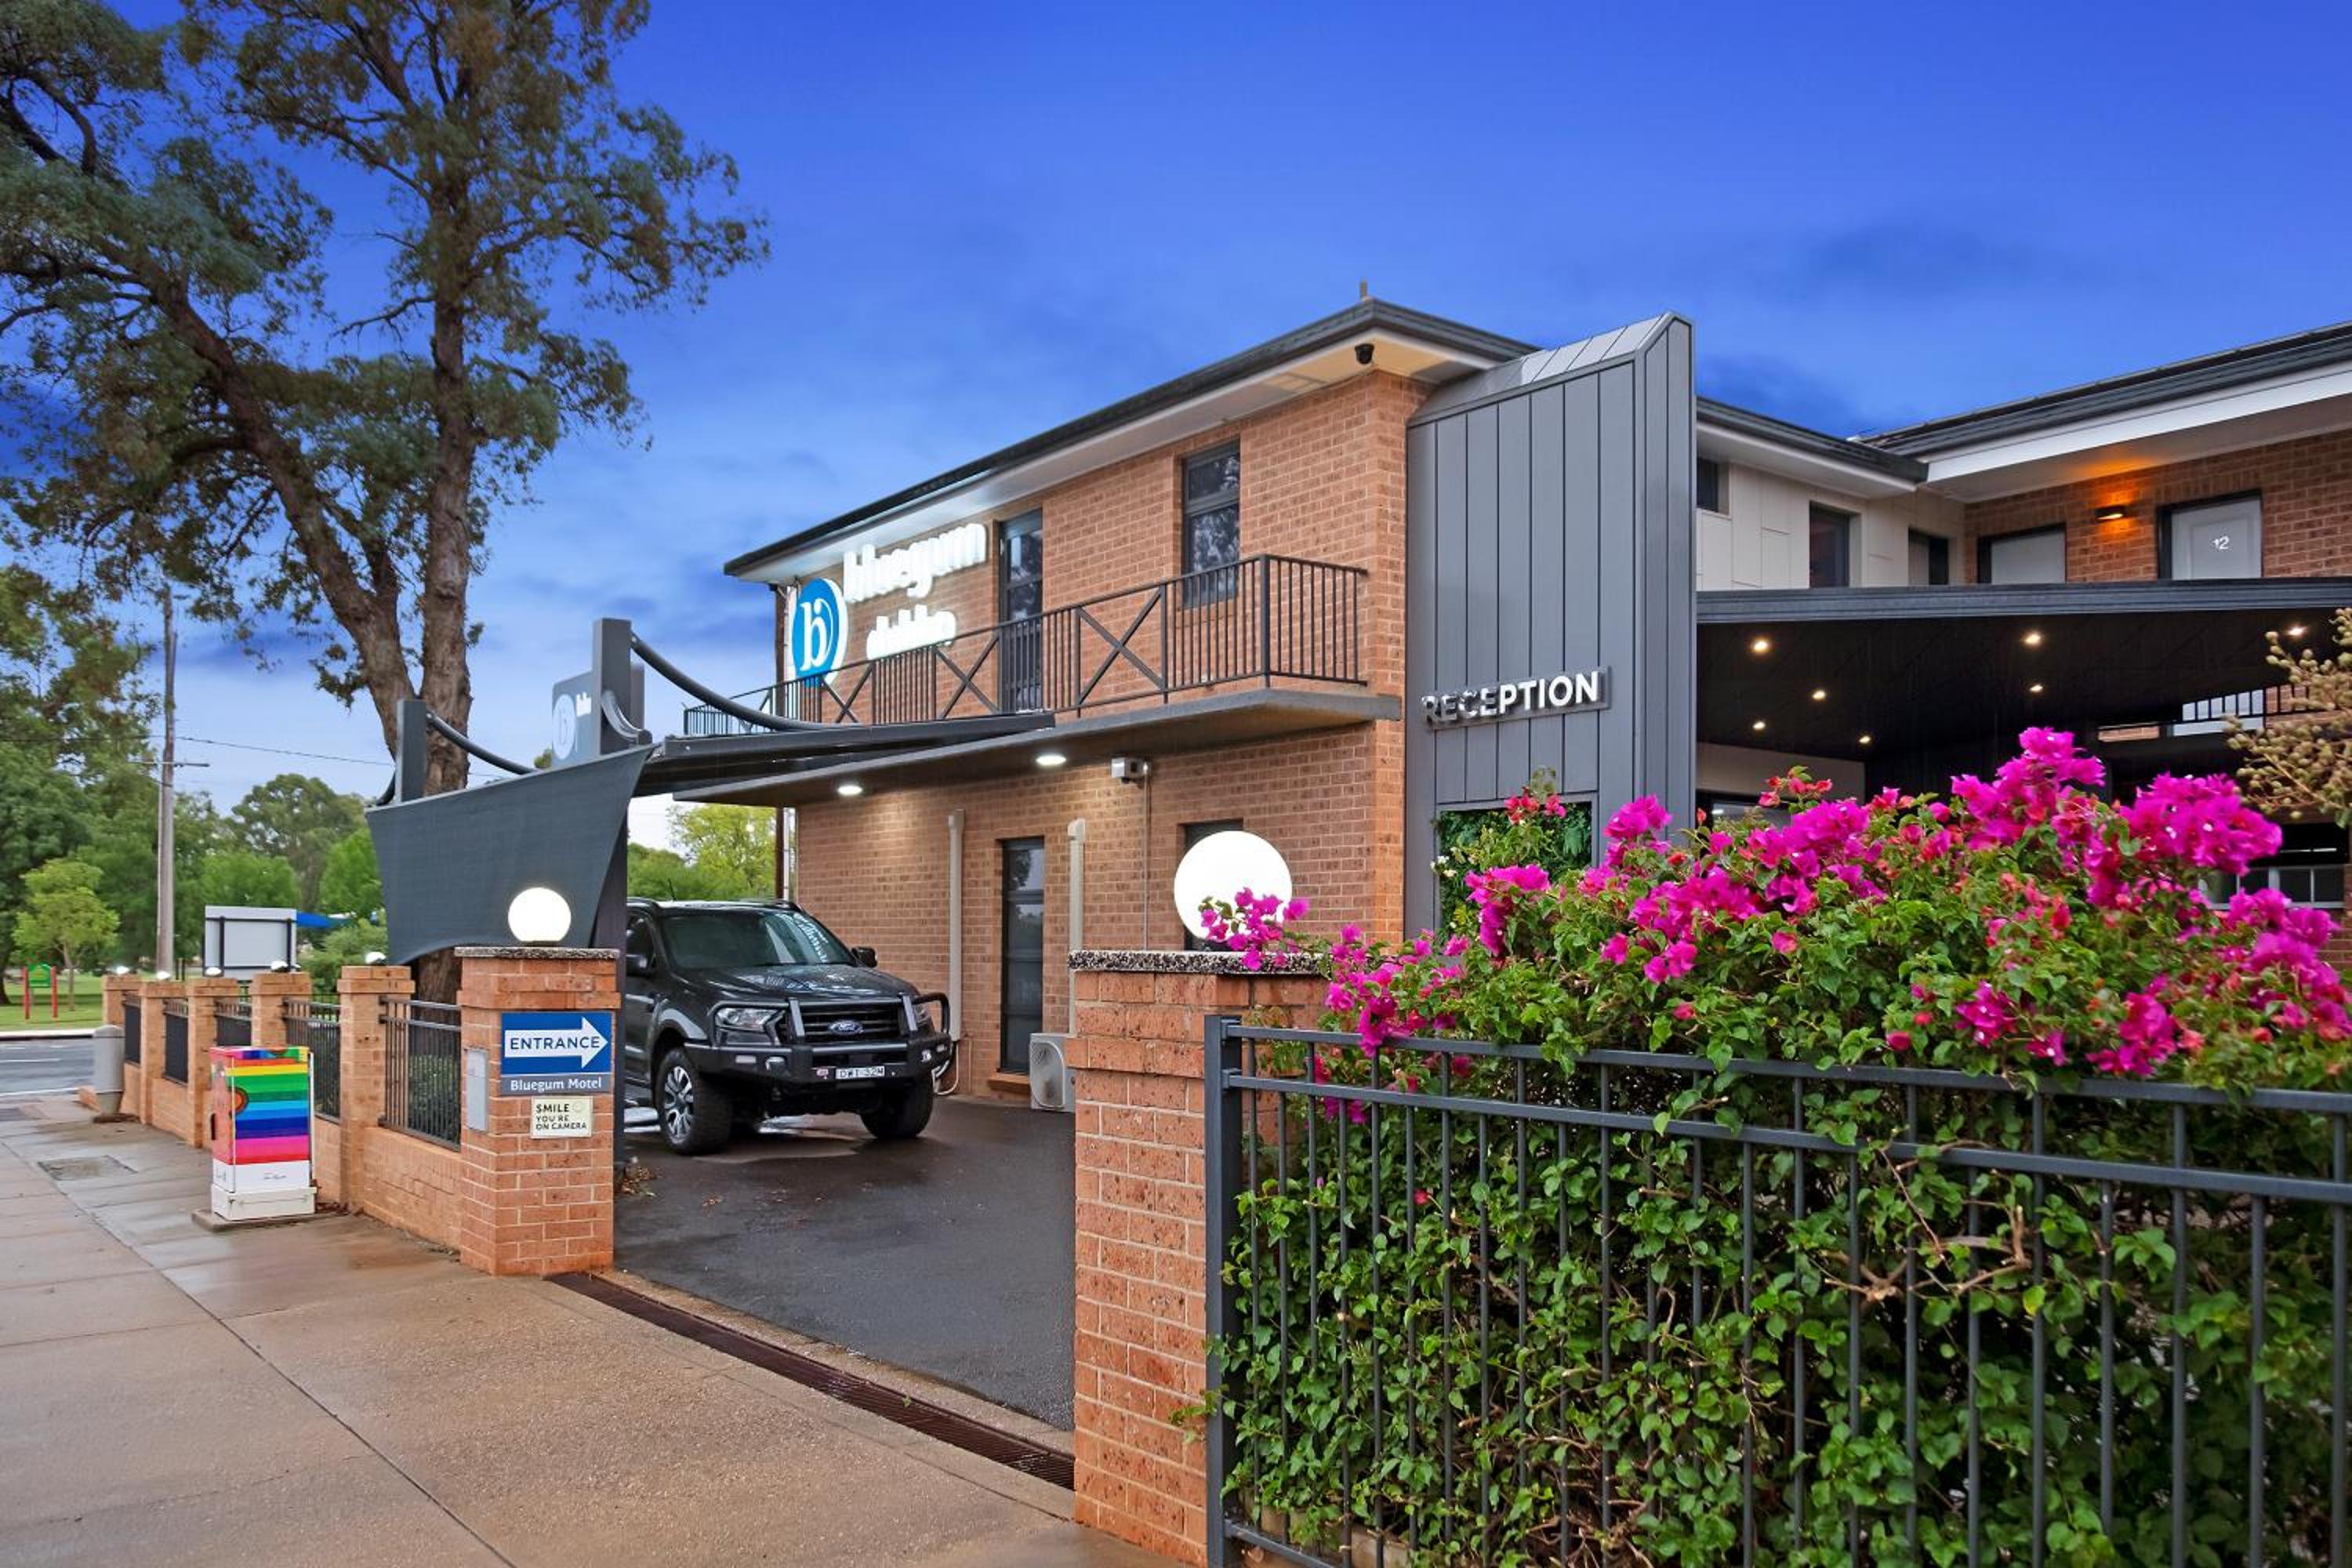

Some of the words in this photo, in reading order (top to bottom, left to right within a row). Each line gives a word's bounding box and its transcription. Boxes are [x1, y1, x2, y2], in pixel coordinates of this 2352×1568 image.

[2211, 535, 2230, 550] 12
[1421, 670, 1599, 723] RECEPTION
[510, 1036, 601, 1051] ENTRANCE
[510, 1079, 565, 1093] Bluegum
[568, 1077, 602, 1090] Motel
[535, 1103, 570, 1113] SMILE
[536, 1114, 570, 1123] YOURE
